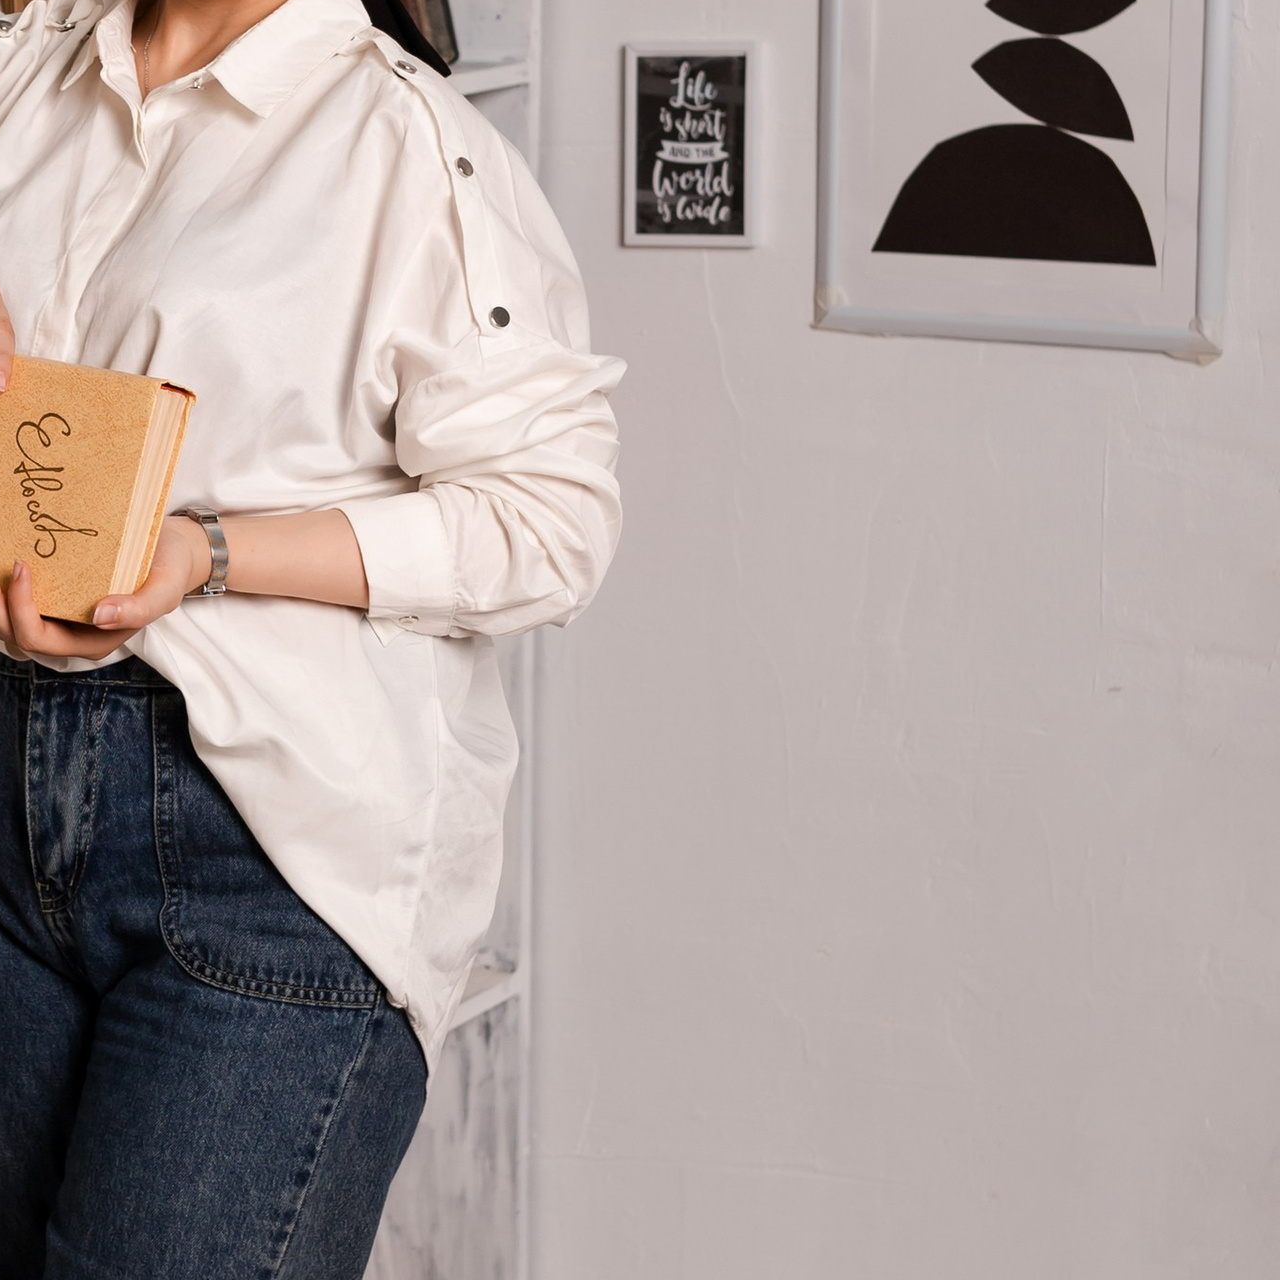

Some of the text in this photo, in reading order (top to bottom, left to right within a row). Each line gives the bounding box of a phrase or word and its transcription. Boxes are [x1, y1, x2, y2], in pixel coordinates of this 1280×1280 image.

[669, 61, 718, 111] Life
[659, 107, 726, 141] is short
[669, 145, 715, 158] AND THE
